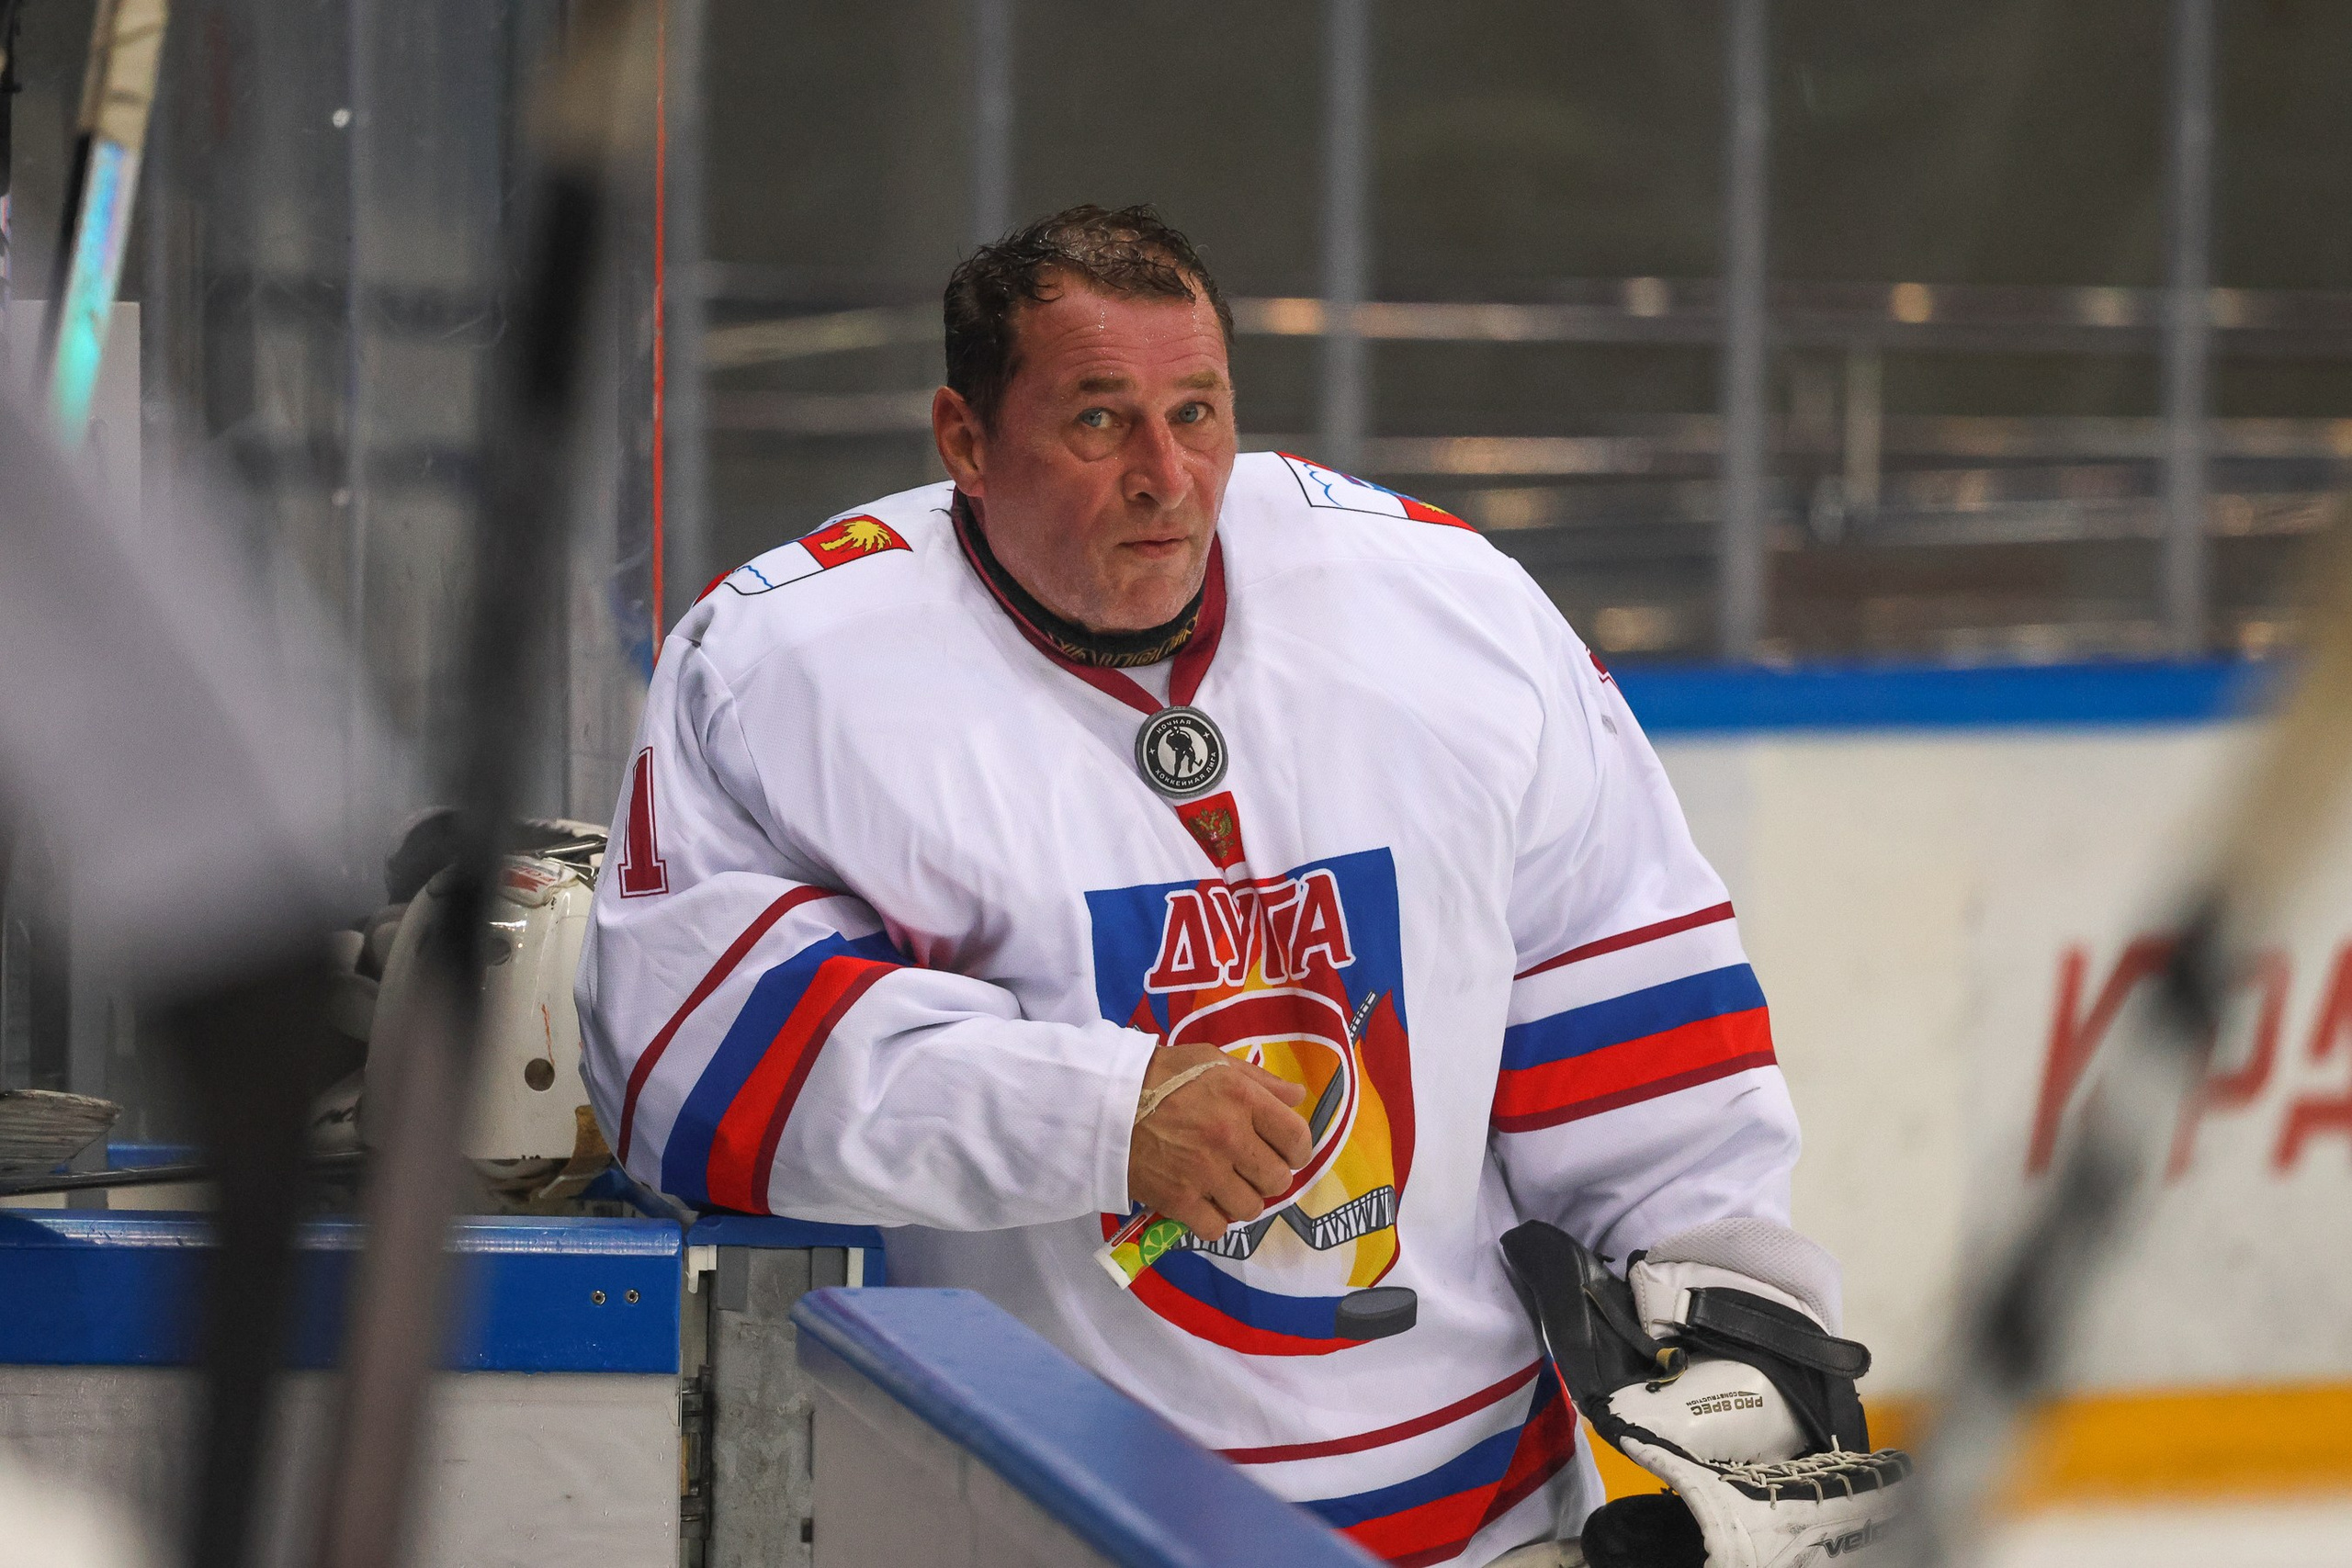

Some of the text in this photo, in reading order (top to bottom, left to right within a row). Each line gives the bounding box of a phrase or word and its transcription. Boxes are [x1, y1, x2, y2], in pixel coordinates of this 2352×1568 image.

[1157, 719, 1192, 734] НОЧНАЯ
[1206, 751, 1217, 773] ЛИГА
[617, 746, 669, 898] 1
[1144, 868, 1355, 994] ДУГА
[1686, 1391, 1738, 1406] CONSTRUCTION
[1690, 1395, 1763, 1416] PRO SPEC
